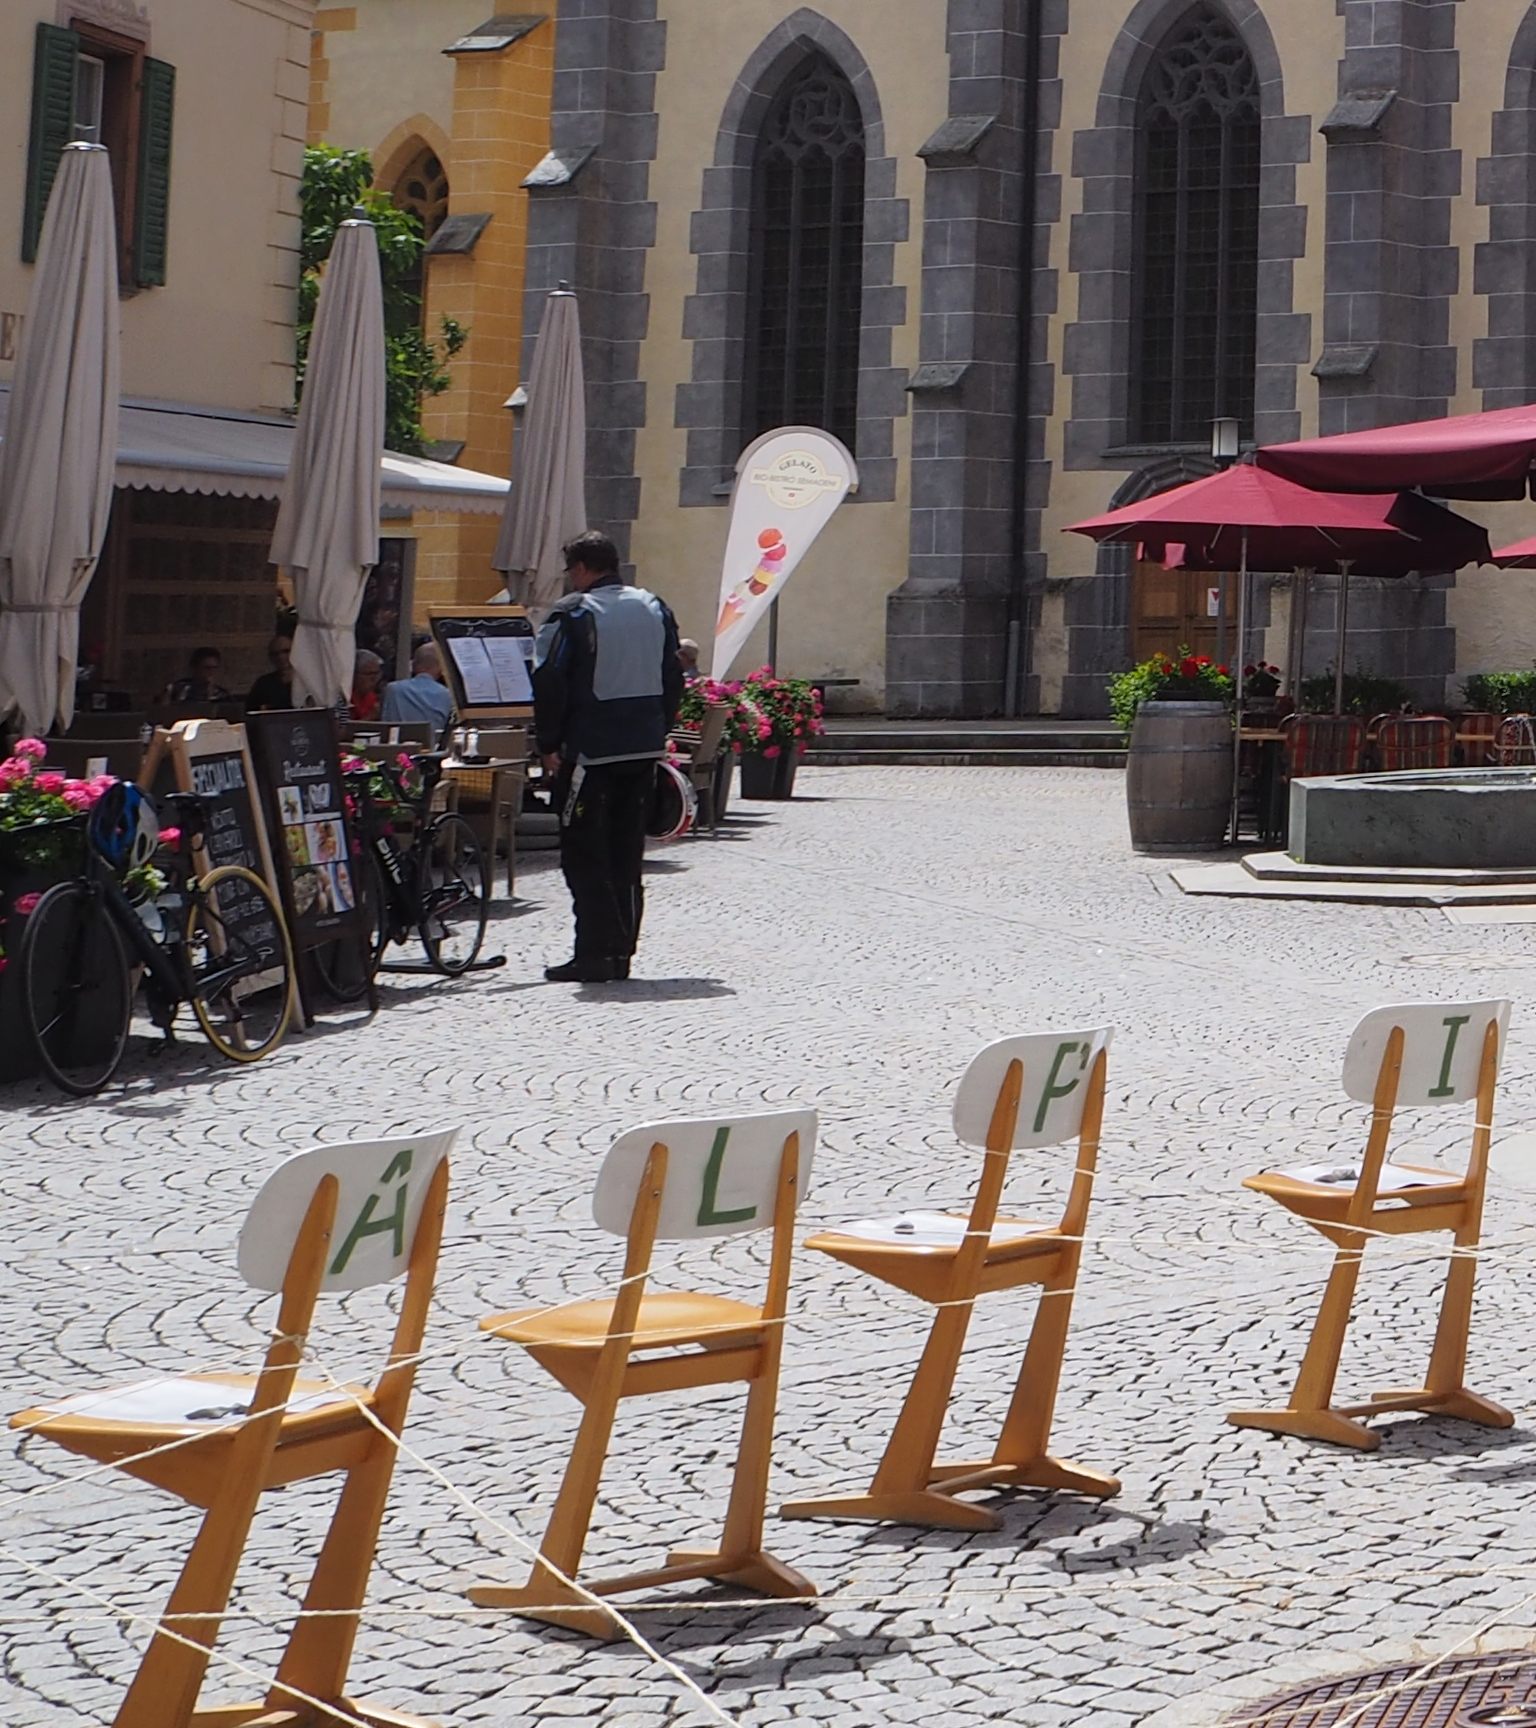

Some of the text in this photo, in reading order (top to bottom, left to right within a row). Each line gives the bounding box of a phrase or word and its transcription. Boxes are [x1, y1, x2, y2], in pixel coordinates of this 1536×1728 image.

[778, 458, 818, 474] GELATO
[329, 1149, 414, 1275] A
[697, 1126, 757, 1226] L
[1033, 1042, 1092, 1133] P
[1428, 1015, 1470, 1098] I
